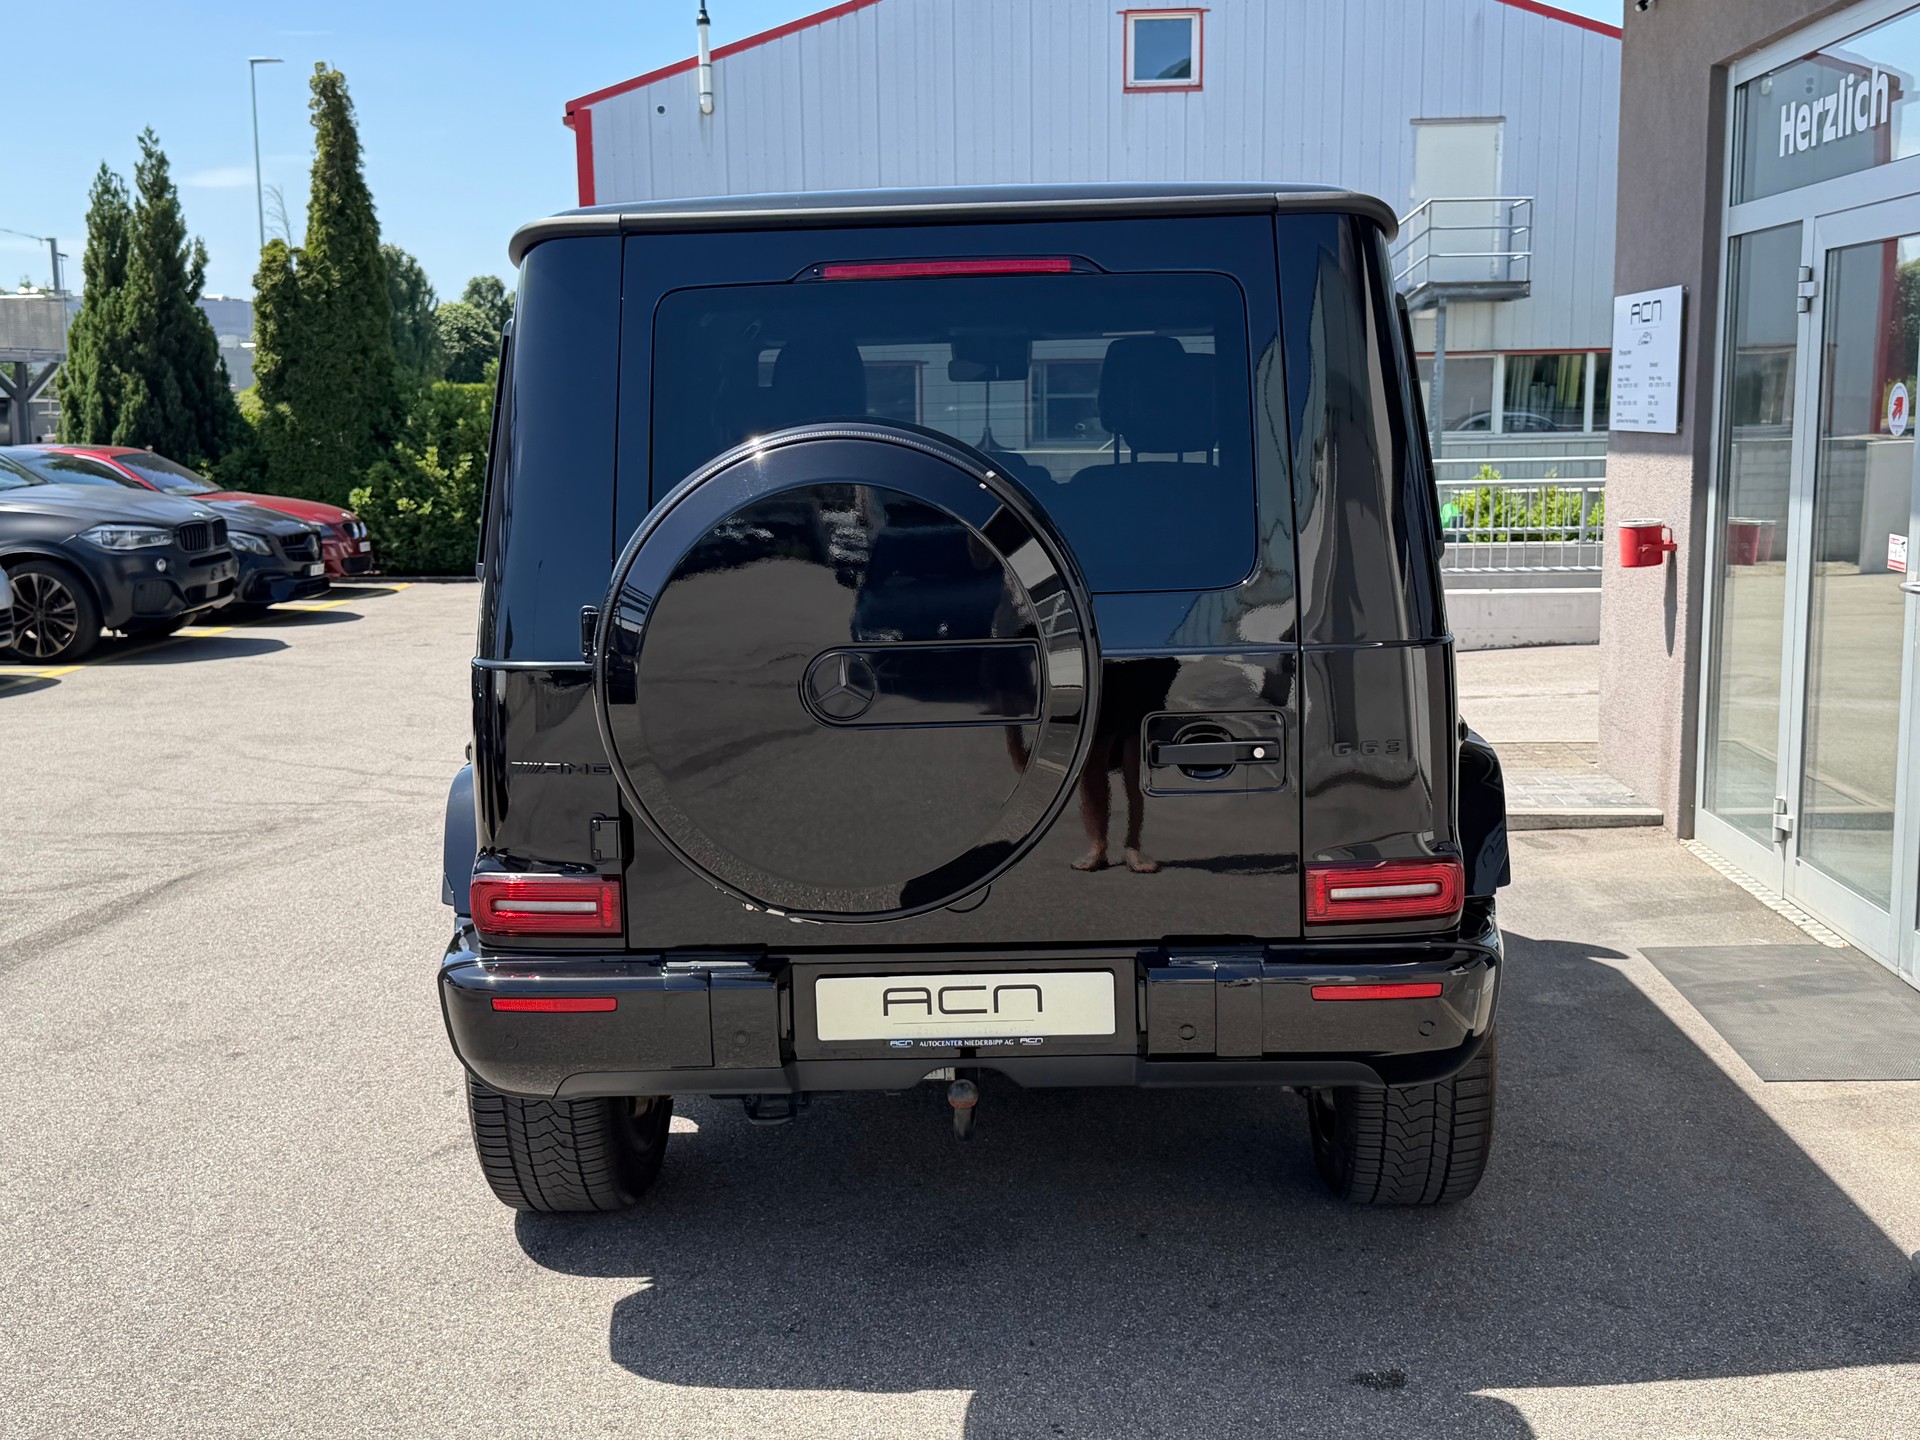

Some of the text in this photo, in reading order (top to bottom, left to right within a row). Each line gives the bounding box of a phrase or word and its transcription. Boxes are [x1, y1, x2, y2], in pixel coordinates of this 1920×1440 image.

[1779, 65, 1889, 157] Herzlich
[542, 762, 612, 775] AMG
[1004, 1038, 1014, 1046] AG
